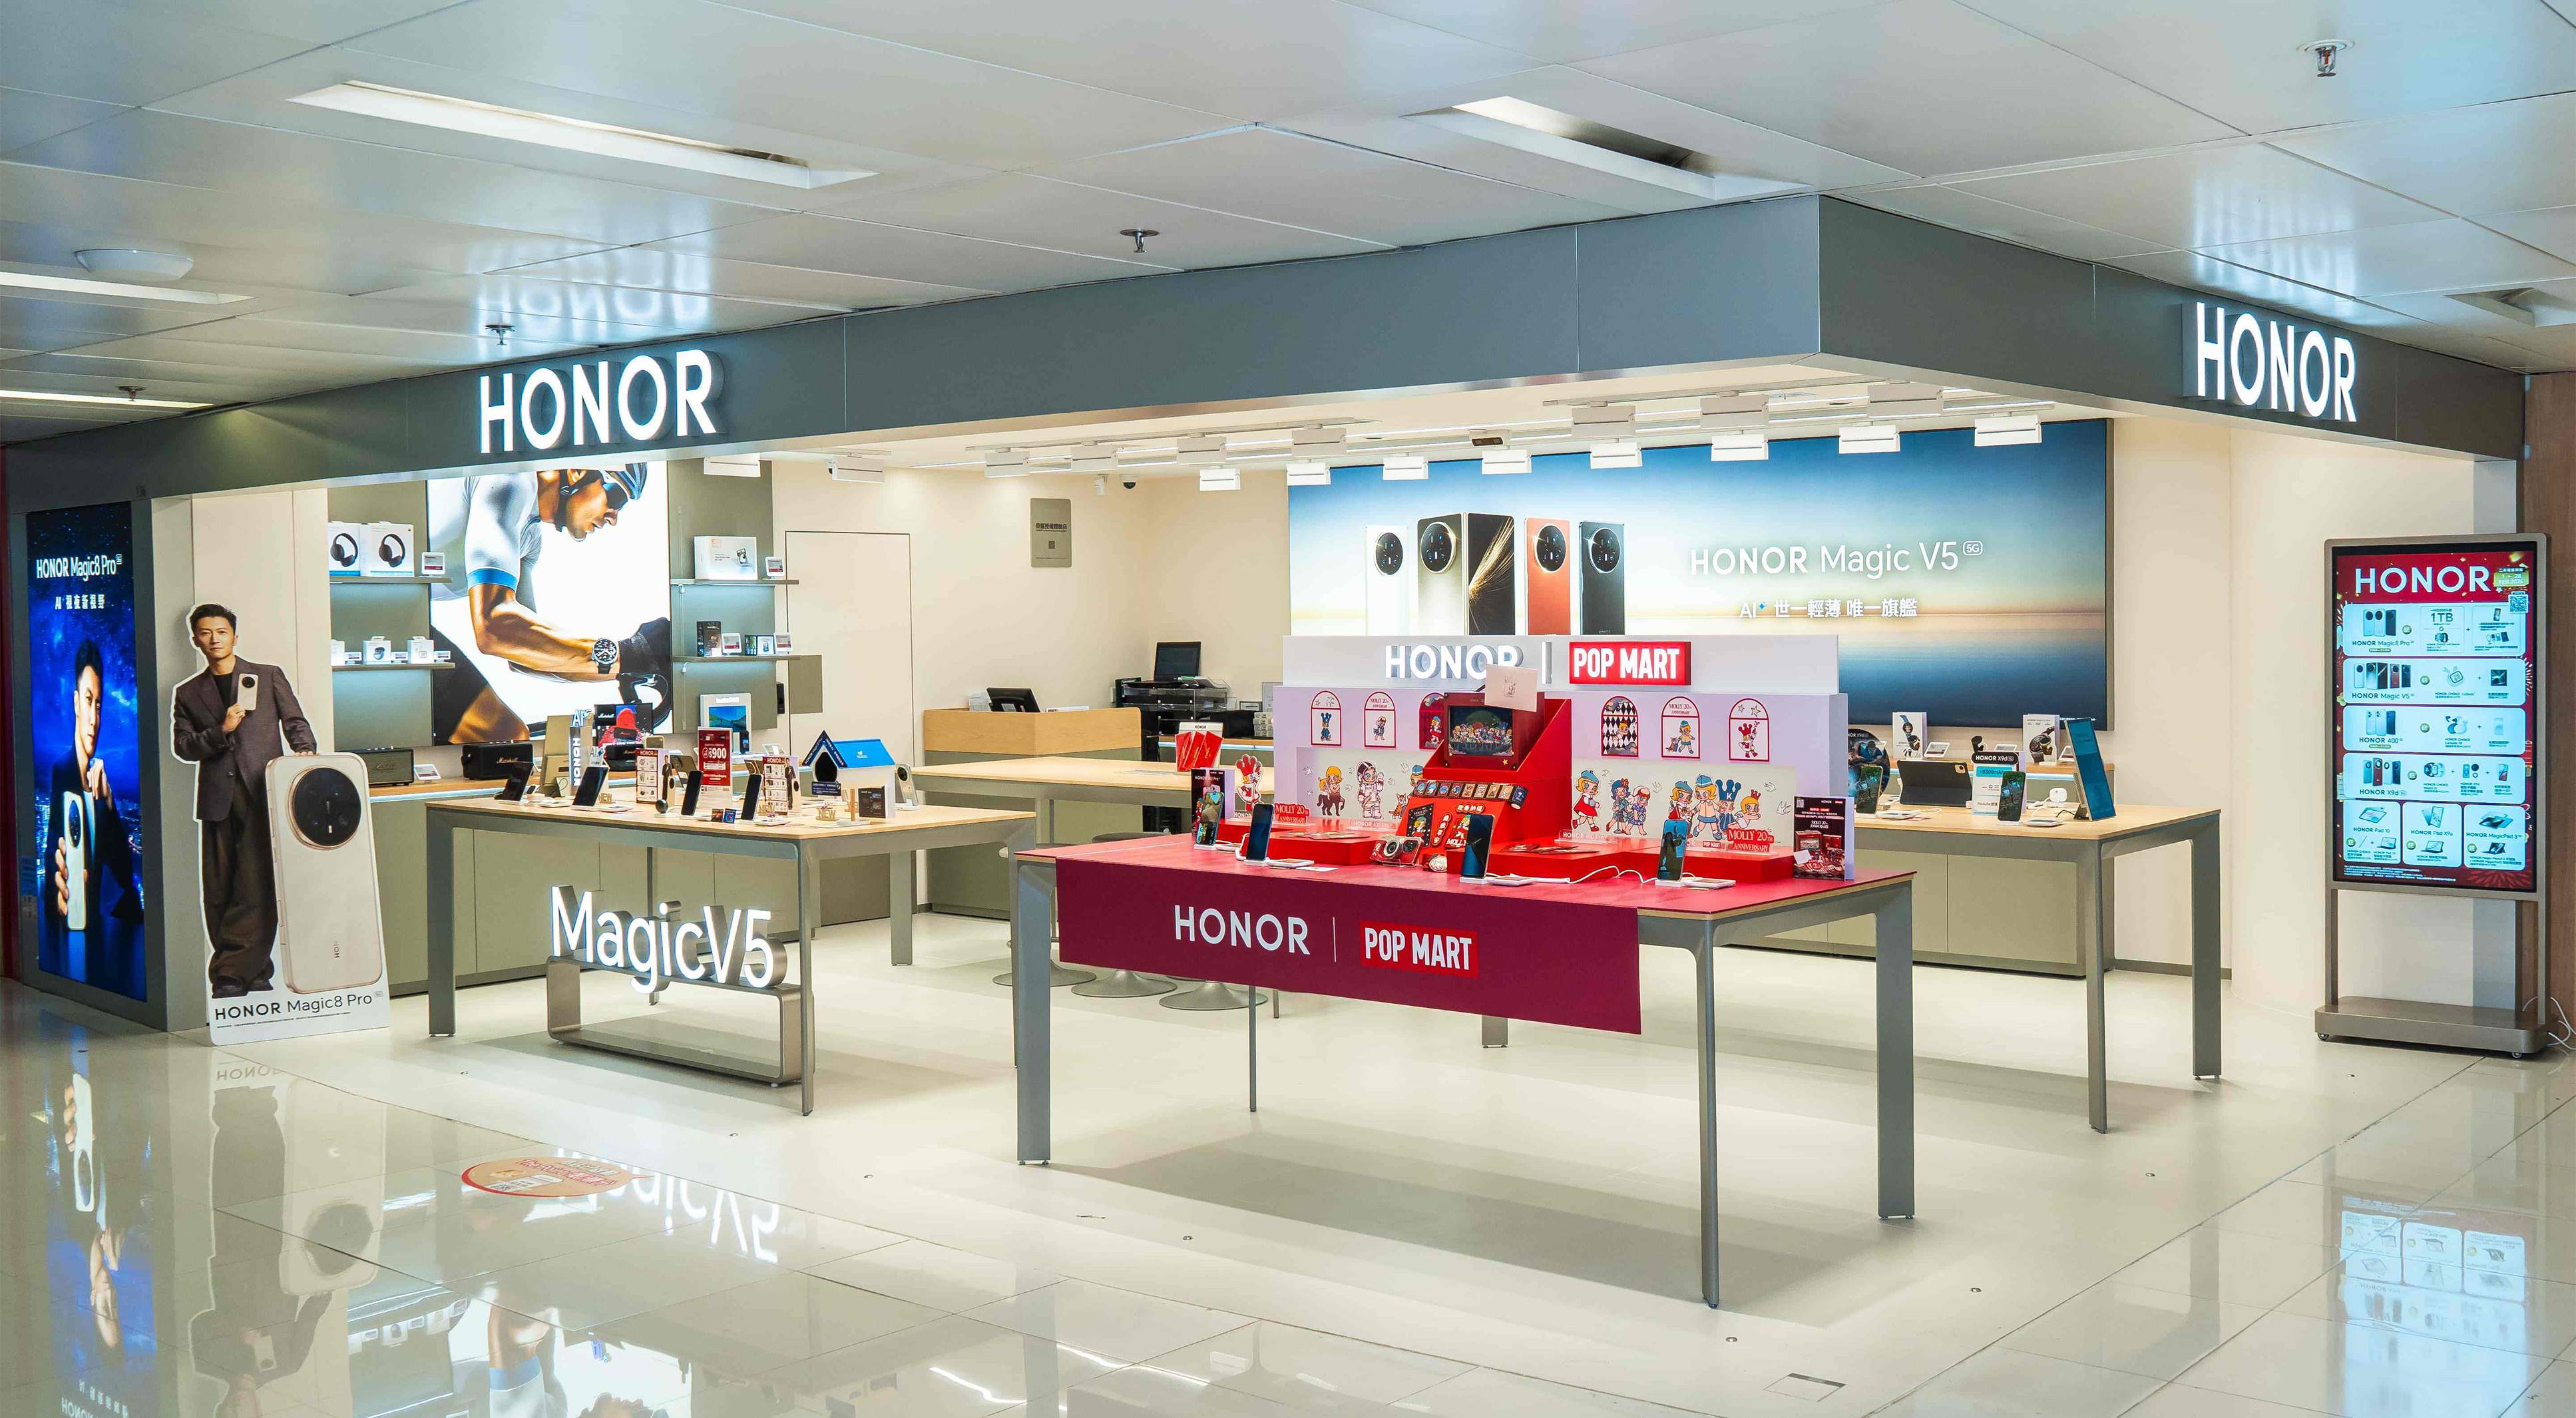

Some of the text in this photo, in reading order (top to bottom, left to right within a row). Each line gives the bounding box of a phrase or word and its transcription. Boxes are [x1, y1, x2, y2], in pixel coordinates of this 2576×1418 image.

[2197, 302, 2357, 423] HONOR
[479, 349, 718, 453] HONOR
[36, 557, 69, 579] HONOR
[71, 555, 101, 582] Magic8
[101, 555, 116, 575] Pro
[1691, 545, 1808, 576] HONOR
[1821, 543, 1910, 579] Magic
[1918, 541, 1959, 571] V5
[2355, 566, 2491, 593] HONOR
[1739, 597, 1918, 618] AI 世一輕薄 唯一旗艦
[2430, 612, 2454, 622] 1TB
[1574, 648, 1614, 678] POP
[1620, 648, 1679, 680] MART
[1275, 804, 1295, 814] MOLLY
[1730, 830, 1755, 840] MOLLY
[1733, 843, 1769, 853] ANNIVERSARY
[1174, 905, 1472, 970] HONOR POP MART
[215, 1002, 282, 1021] HONOR
[287, 995, 343, 1014] Magic8
[347, 993, 373, 1007] Pro
